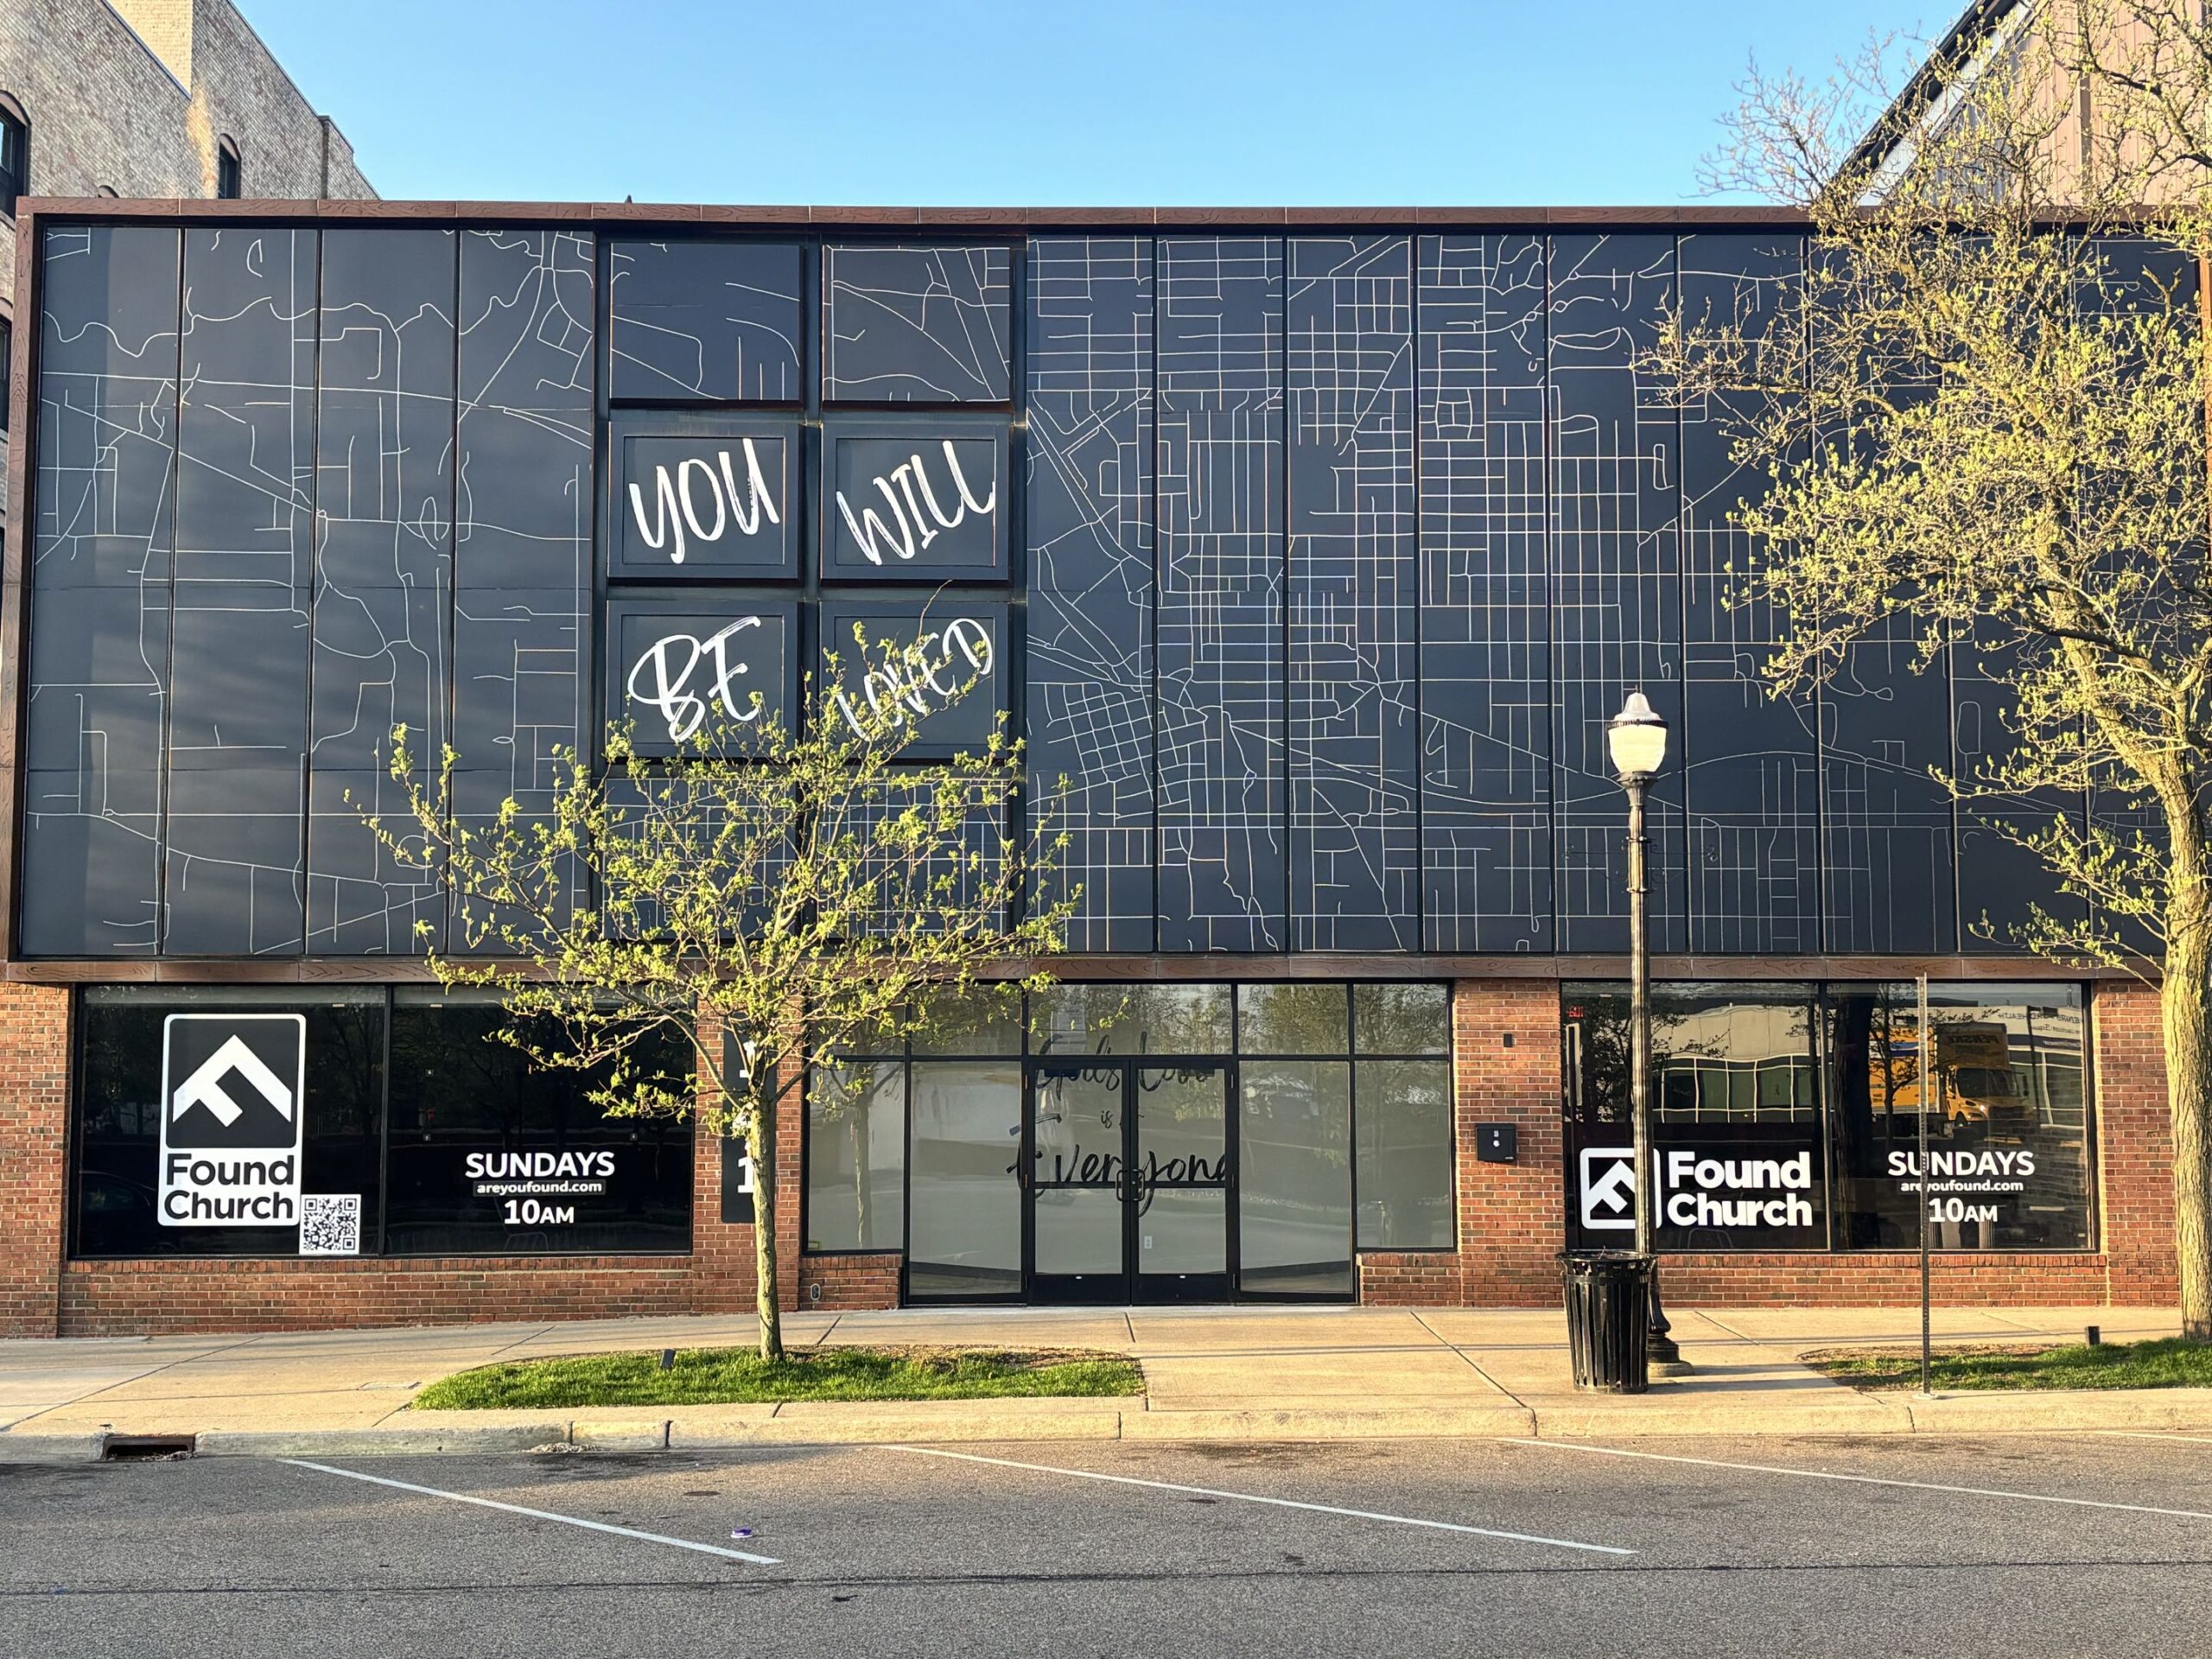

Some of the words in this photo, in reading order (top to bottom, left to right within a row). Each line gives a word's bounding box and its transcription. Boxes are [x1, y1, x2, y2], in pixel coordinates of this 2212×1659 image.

[629, 438, 780, 563] YOU
[836, 440, 996, 566] WILL
[627, 615, 762, 742] BE
[166, 1153, 295, 1185] Found
[465, 1151, 615, 1179] SUNDAYS
[1668, 1151, 1811, 1188] Found
[1887, 1150, 2036, 1176] SUNDAYS
[477, 1180, 602, 1196] areyoufound.com
[163, 1189, 294, 1220] Church
[504, 1198, 575, 1224] 10AM
[1667, 1192, 1813, 1226] Church
[1928, 1197, 1998, 1223] 10AM
